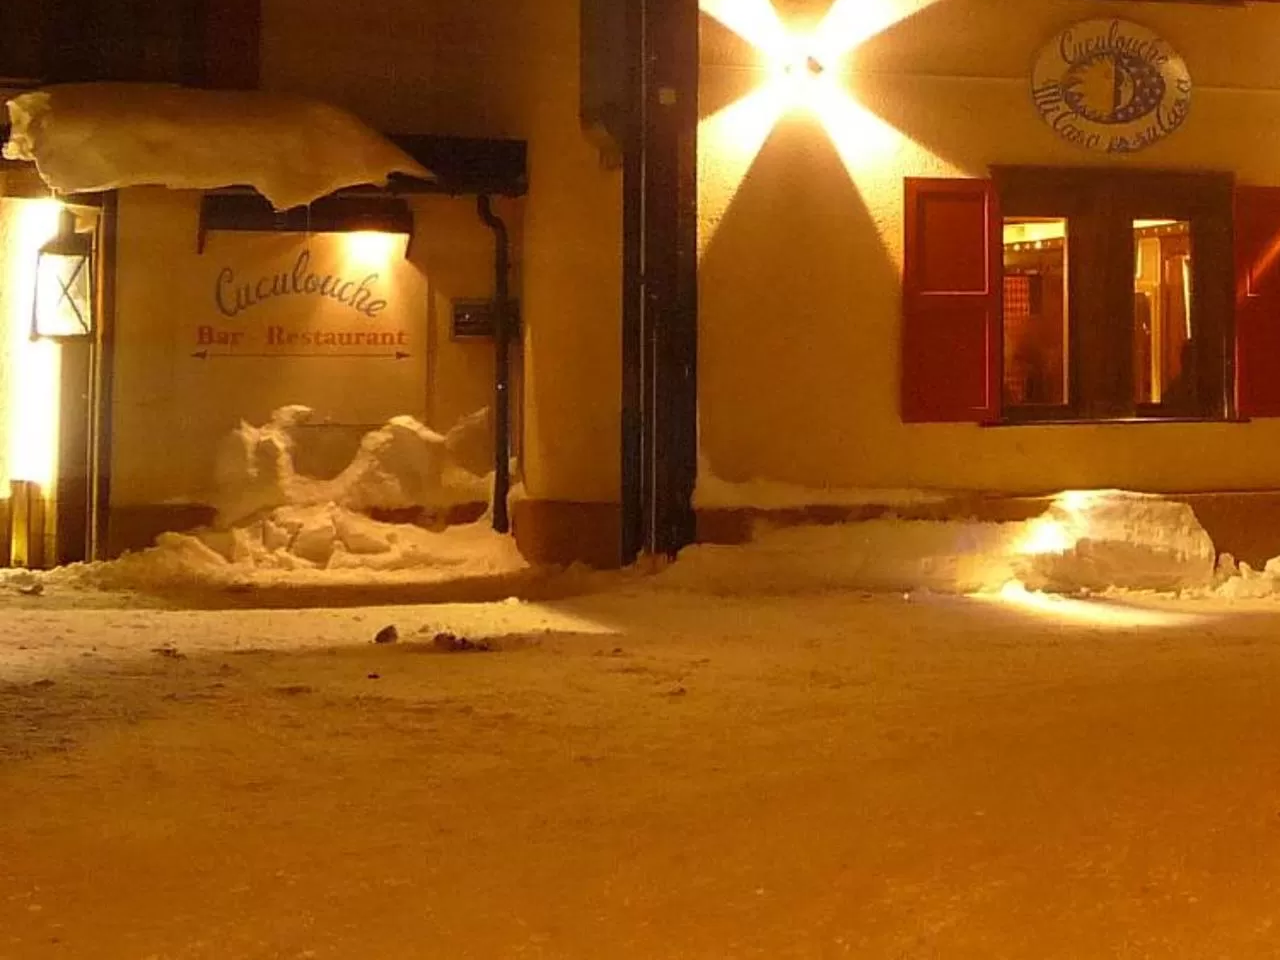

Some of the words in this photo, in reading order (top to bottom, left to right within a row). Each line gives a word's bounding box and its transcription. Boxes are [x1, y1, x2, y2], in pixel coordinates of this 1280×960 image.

[215, 249, 388, 317] Cuculouche
[197, 325, 245, 345] Bar
[267, 325, 409, 345] Restaurant
